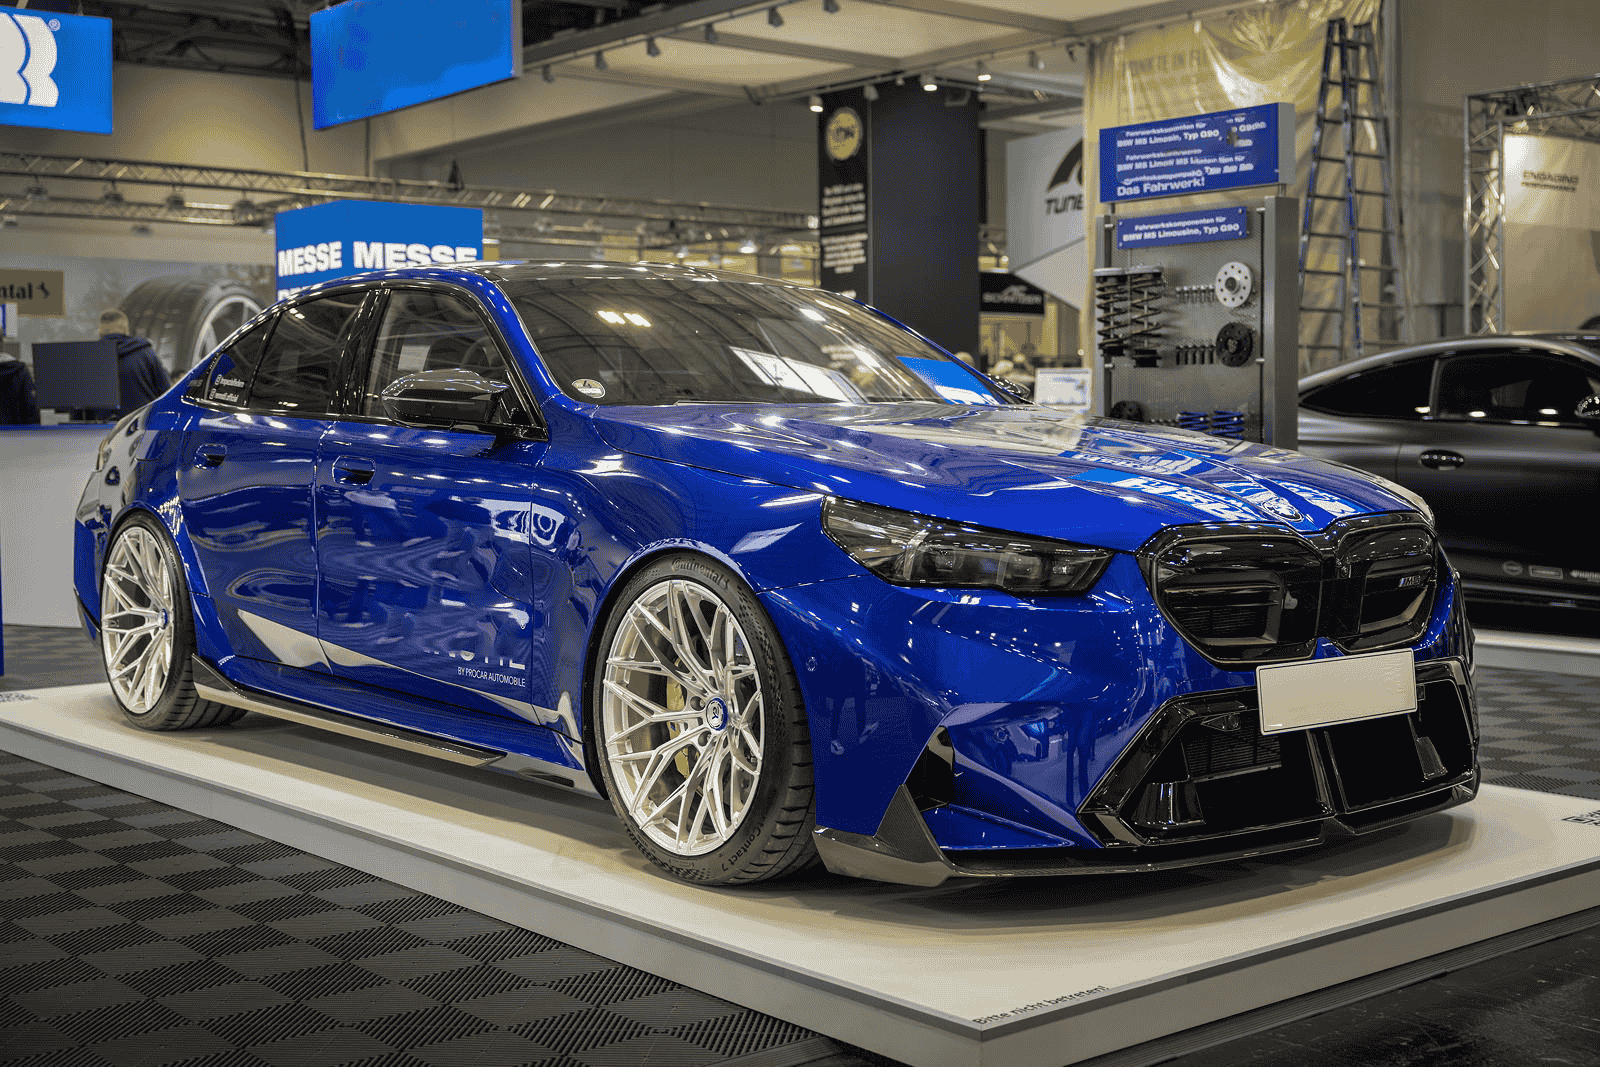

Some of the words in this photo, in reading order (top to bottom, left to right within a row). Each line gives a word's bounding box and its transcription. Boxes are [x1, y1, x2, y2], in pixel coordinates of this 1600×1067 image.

[1183, 132, 1199, 141] Typ
[1117, 185, 1140, 197] Das
[1143, 177, 1205, 194] Fahrwerk!
[1215, 215, 1227, 223] für
[1123, 232, 1143, 242] BMW
[1203, 226, 1219, 235] Typ
[277, 240, 343, 278] MESSE
[353, 240, 478, 270] MESSE
[457, 666, 466, 676] BY
[465, 667, 488, 681] PROCAR
[487, 672, 526, 688] AUTOMOBILE
[972, 1012, 1011, 1025] Bitte
[1010, 1002, 1046, 1015] nicht
